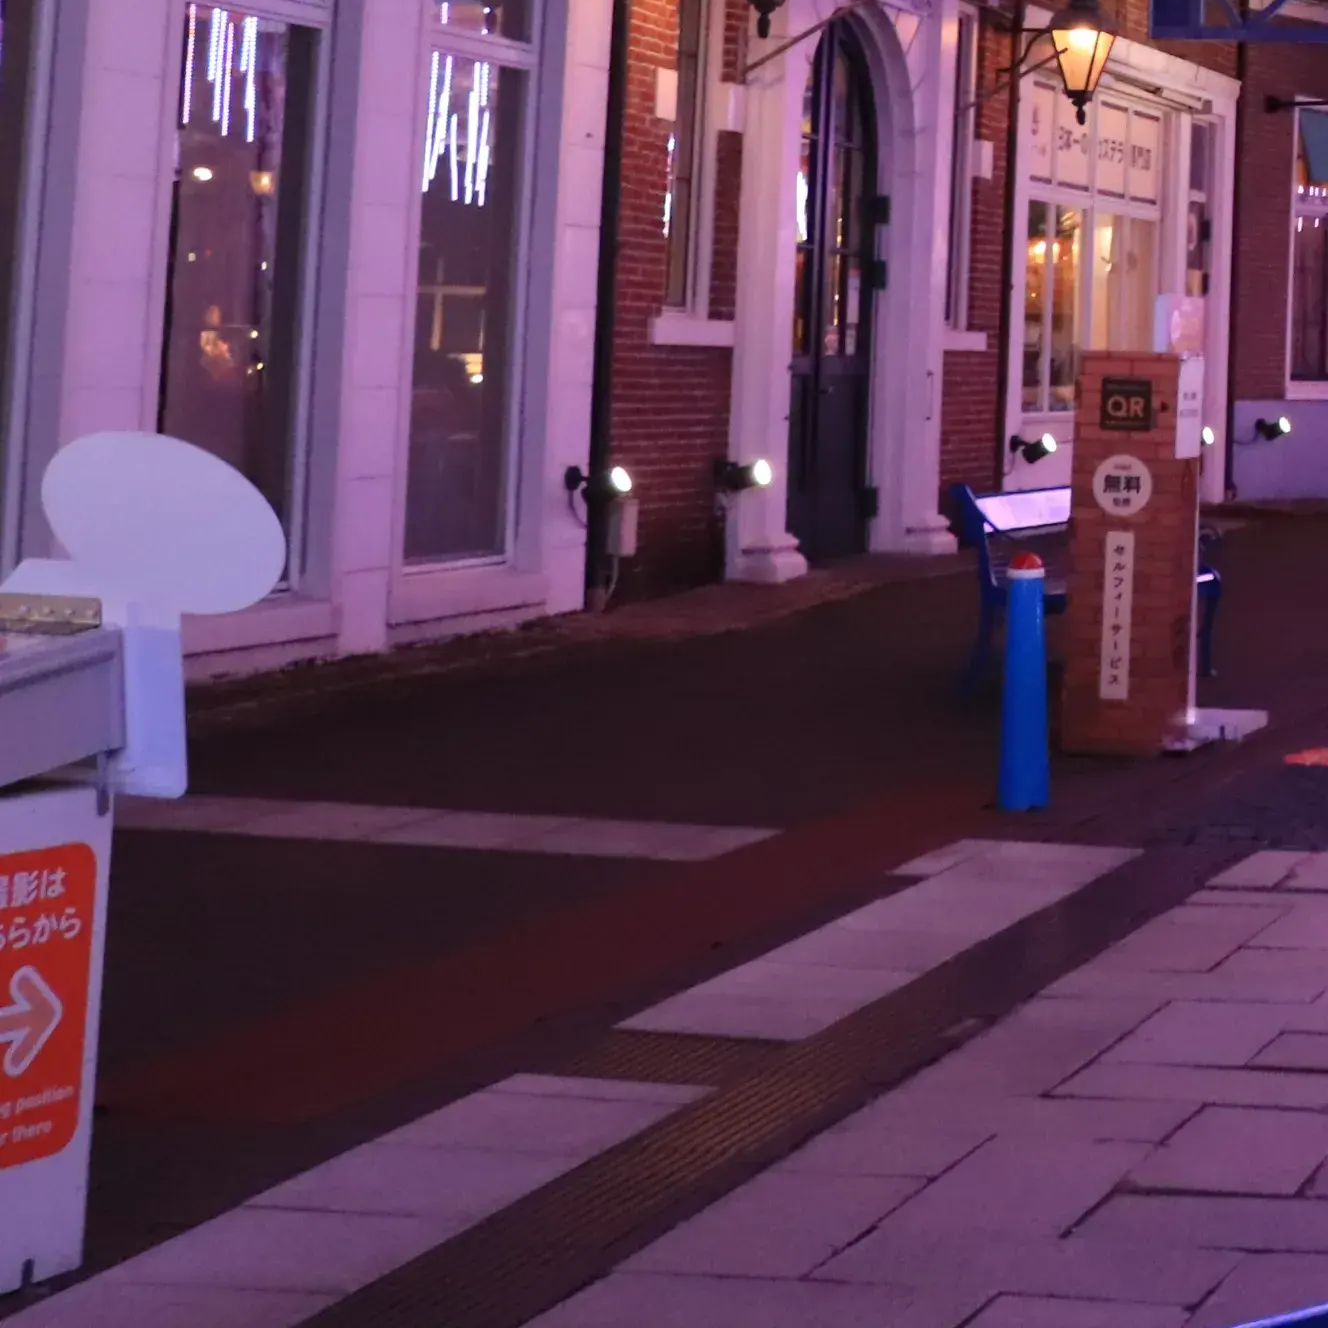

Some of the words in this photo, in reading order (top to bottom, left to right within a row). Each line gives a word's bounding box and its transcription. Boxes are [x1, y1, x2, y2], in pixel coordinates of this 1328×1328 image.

[1107, 395, 1145, 418] QR
[1103, 474, 1142, 495] 無料
[1107, 544, 1126, 686] セルフィーサービス
